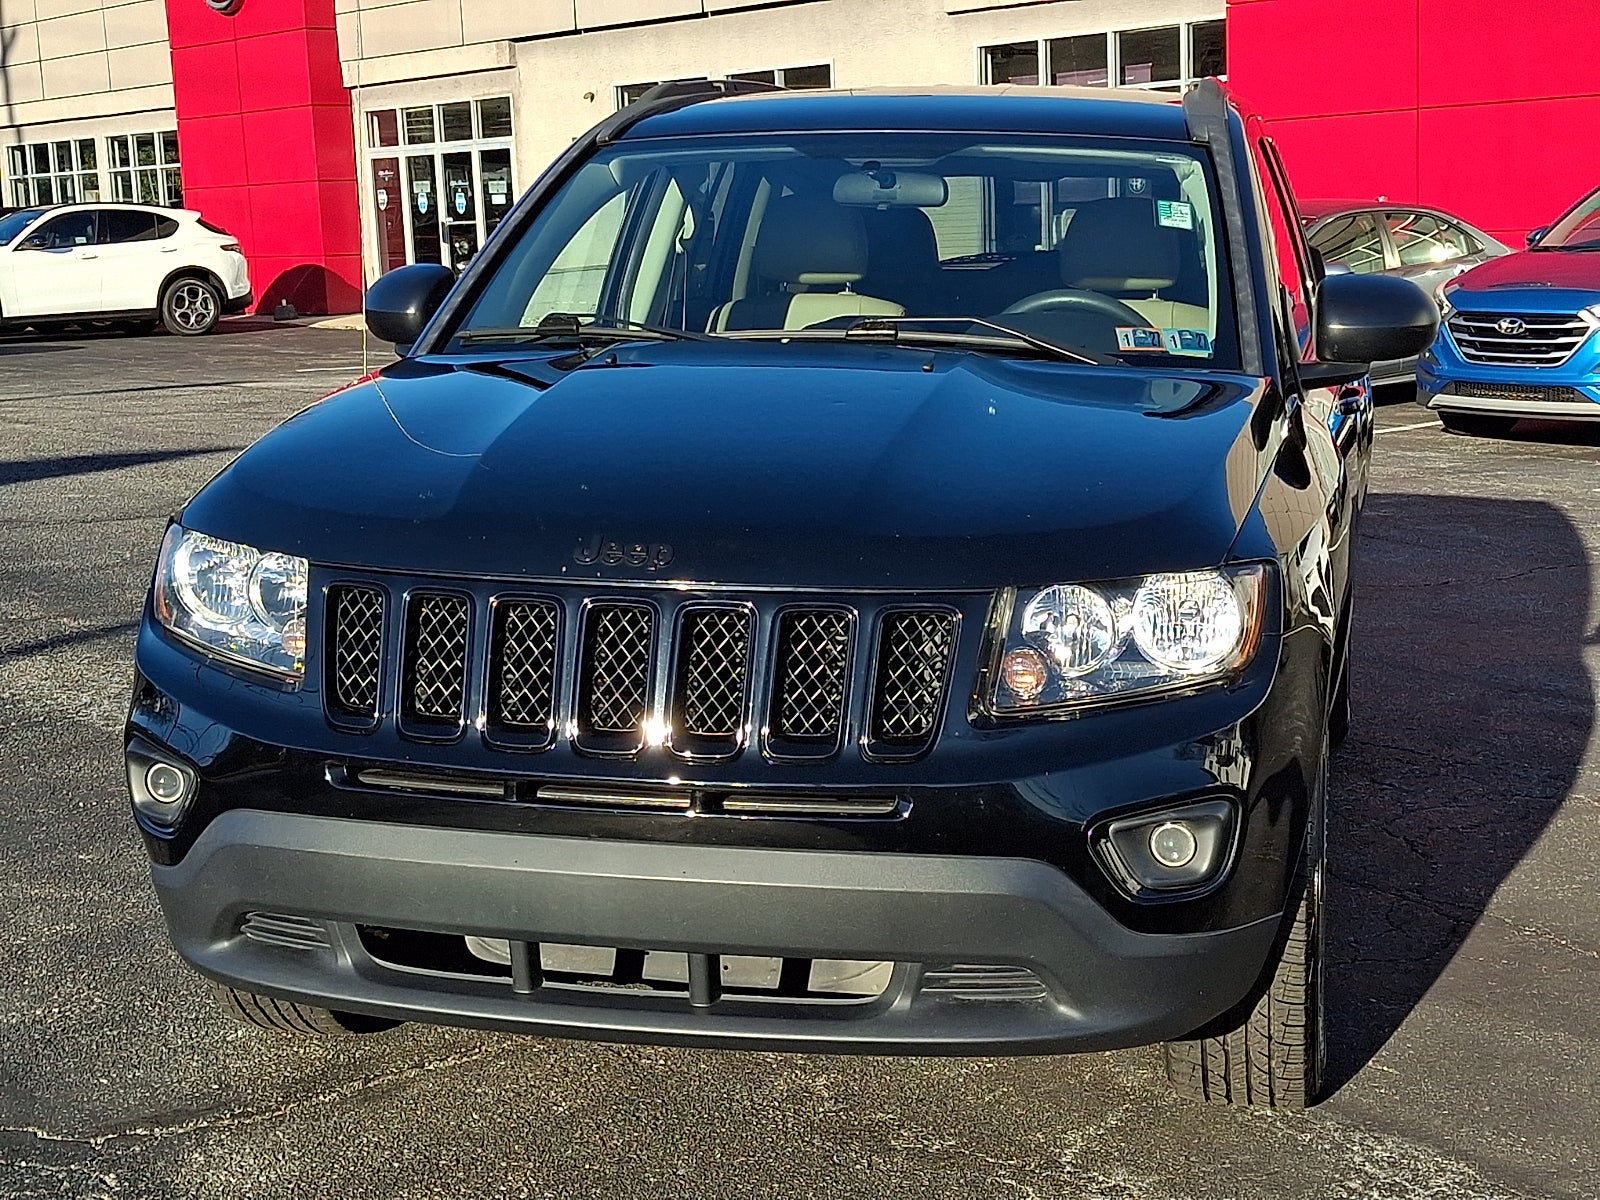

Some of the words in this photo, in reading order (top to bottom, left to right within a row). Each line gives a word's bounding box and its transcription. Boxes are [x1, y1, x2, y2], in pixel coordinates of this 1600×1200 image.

[1123, 333, 1131, 347] 1
[1169, 334, 1178, 349] 1
[573, 534, 675, 573] Jeep
